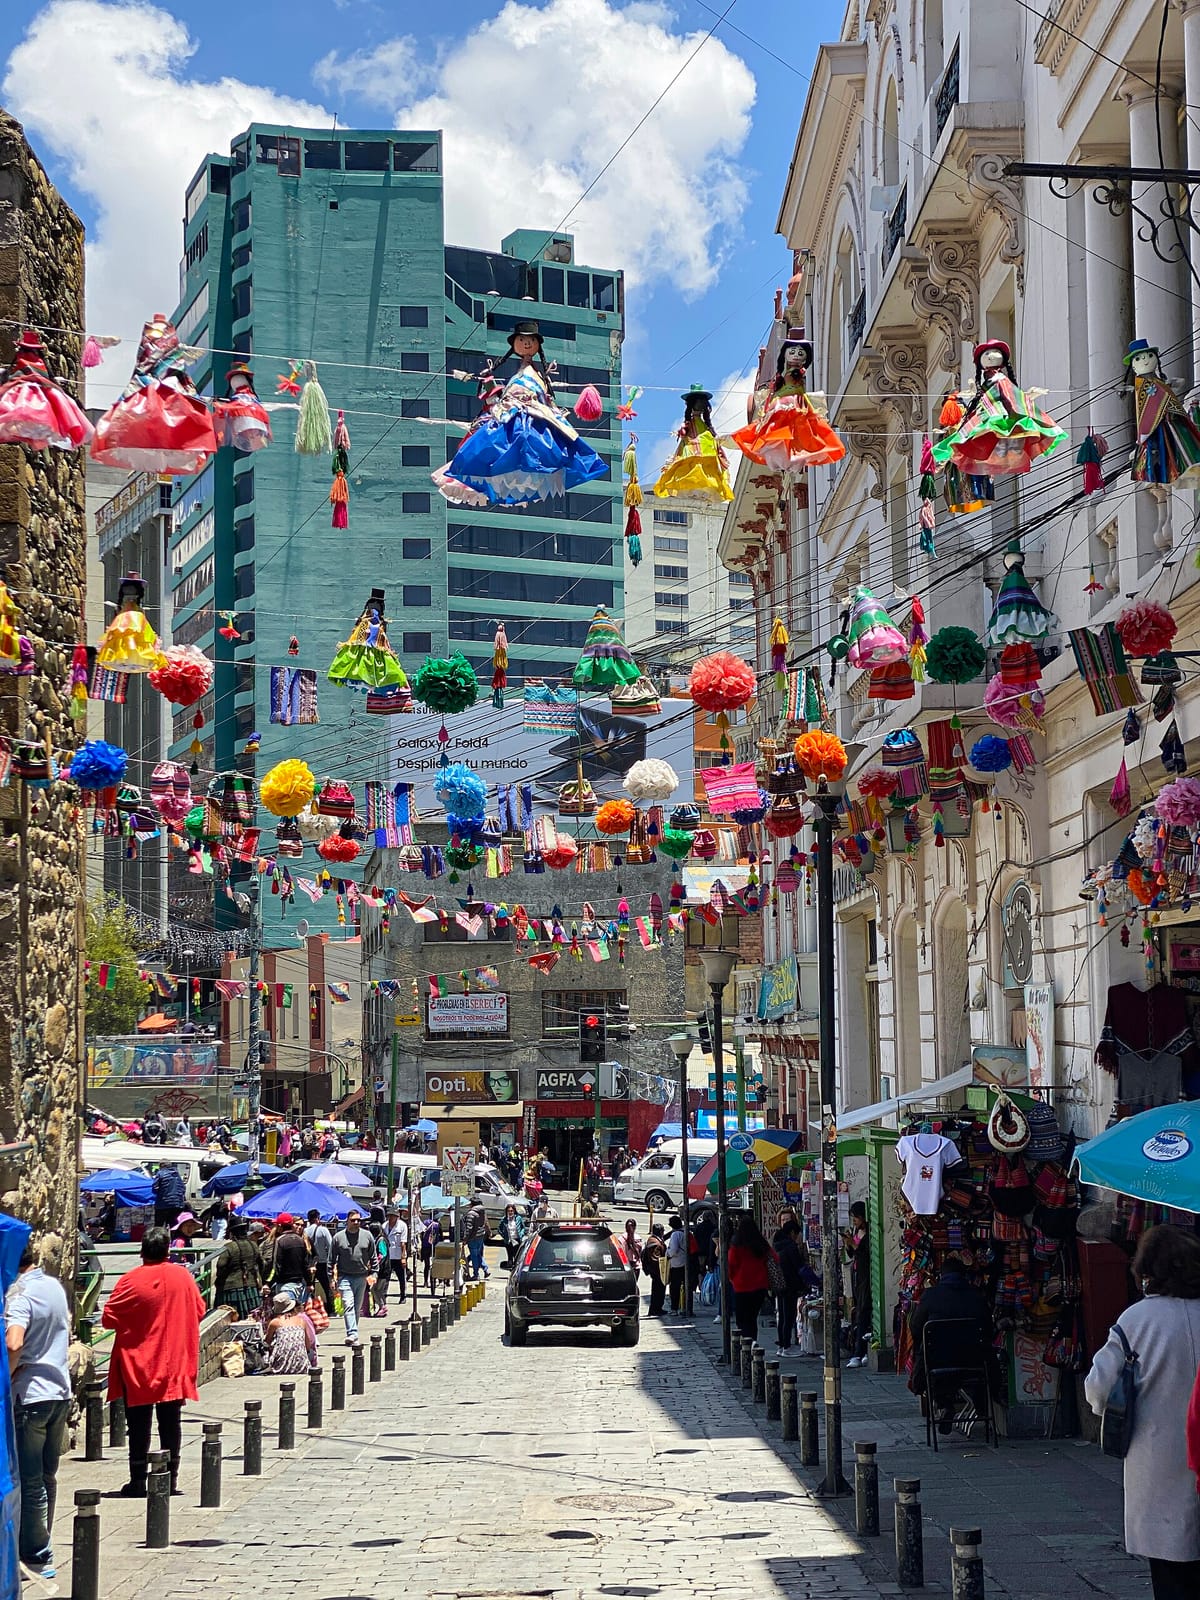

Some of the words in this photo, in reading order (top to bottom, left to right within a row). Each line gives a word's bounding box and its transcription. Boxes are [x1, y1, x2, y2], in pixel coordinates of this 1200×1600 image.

[398, 738, 441, 751] Galaxy
[455, 738, 490, 748] Fold4
[466, 759, 478, 769] tu
[481, 758, 528, 769] mundo
[538, 1073, 577, 1087] AGFA
